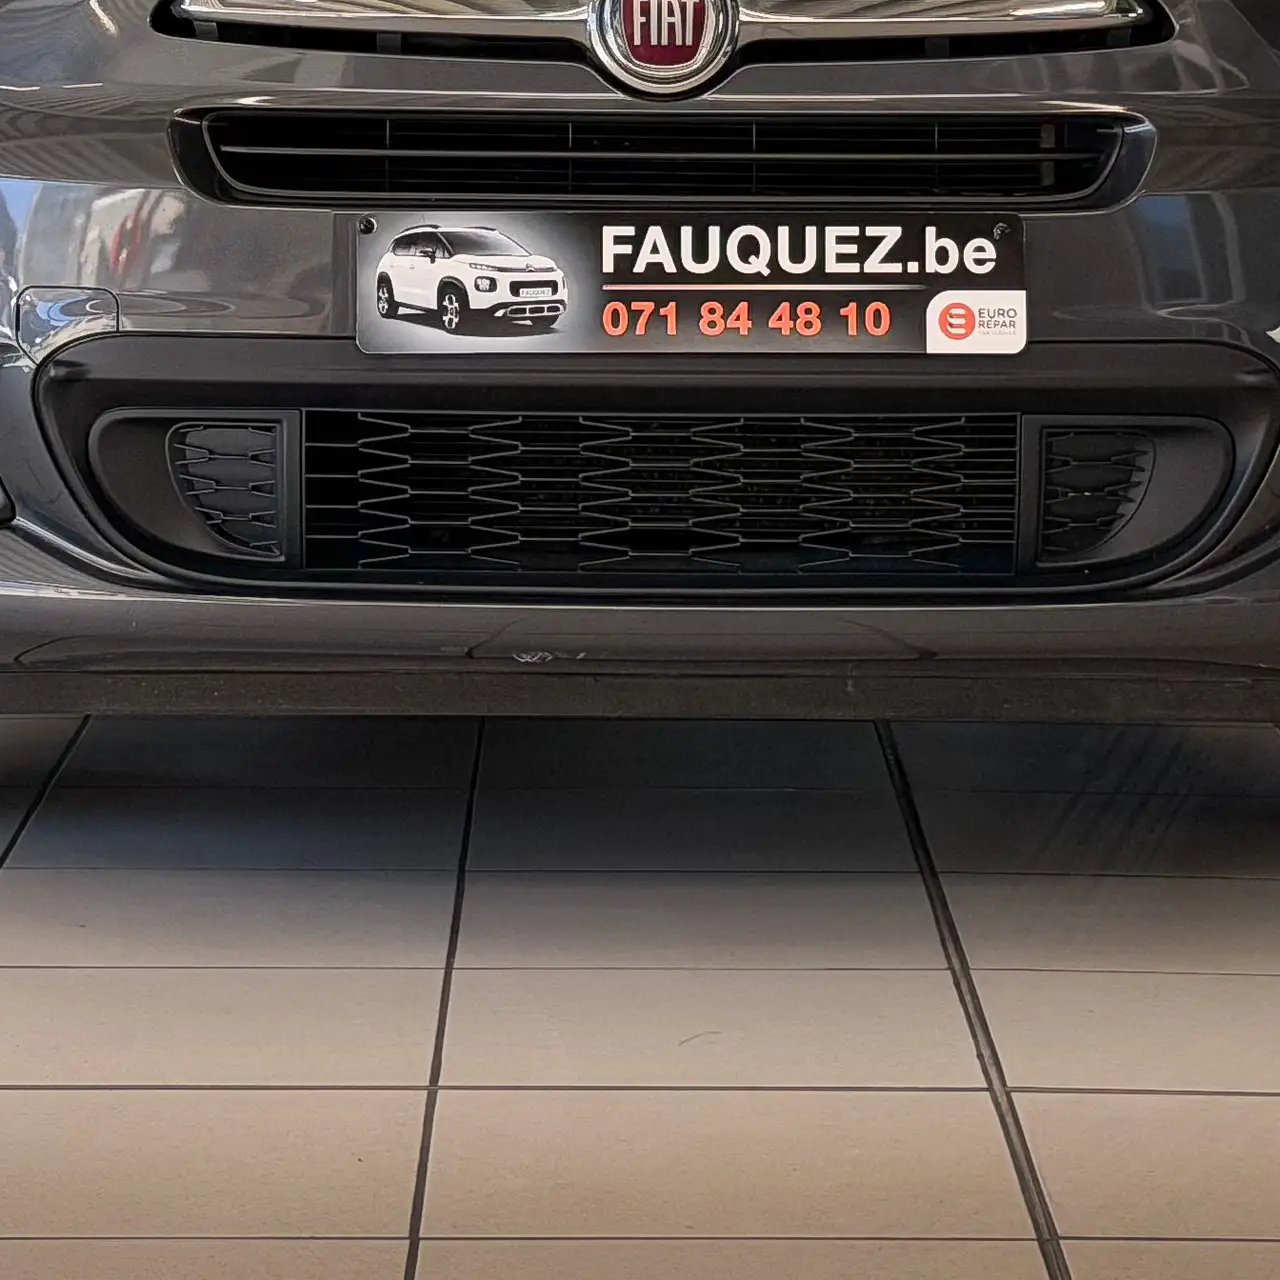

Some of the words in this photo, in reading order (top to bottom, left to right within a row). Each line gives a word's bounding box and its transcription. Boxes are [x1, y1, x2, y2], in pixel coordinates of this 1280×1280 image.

[601, 224, 998, 277] FAUQUEZ.be
[602, 301, 677, 336] 071
[699, 301, 752, 336] 84
[768, 301, 822, 336] 48
[839, 301, 891, 336] 10
[978, 308, 1018, 319] EURO
[978, 320, 1016, 329] REPAR
